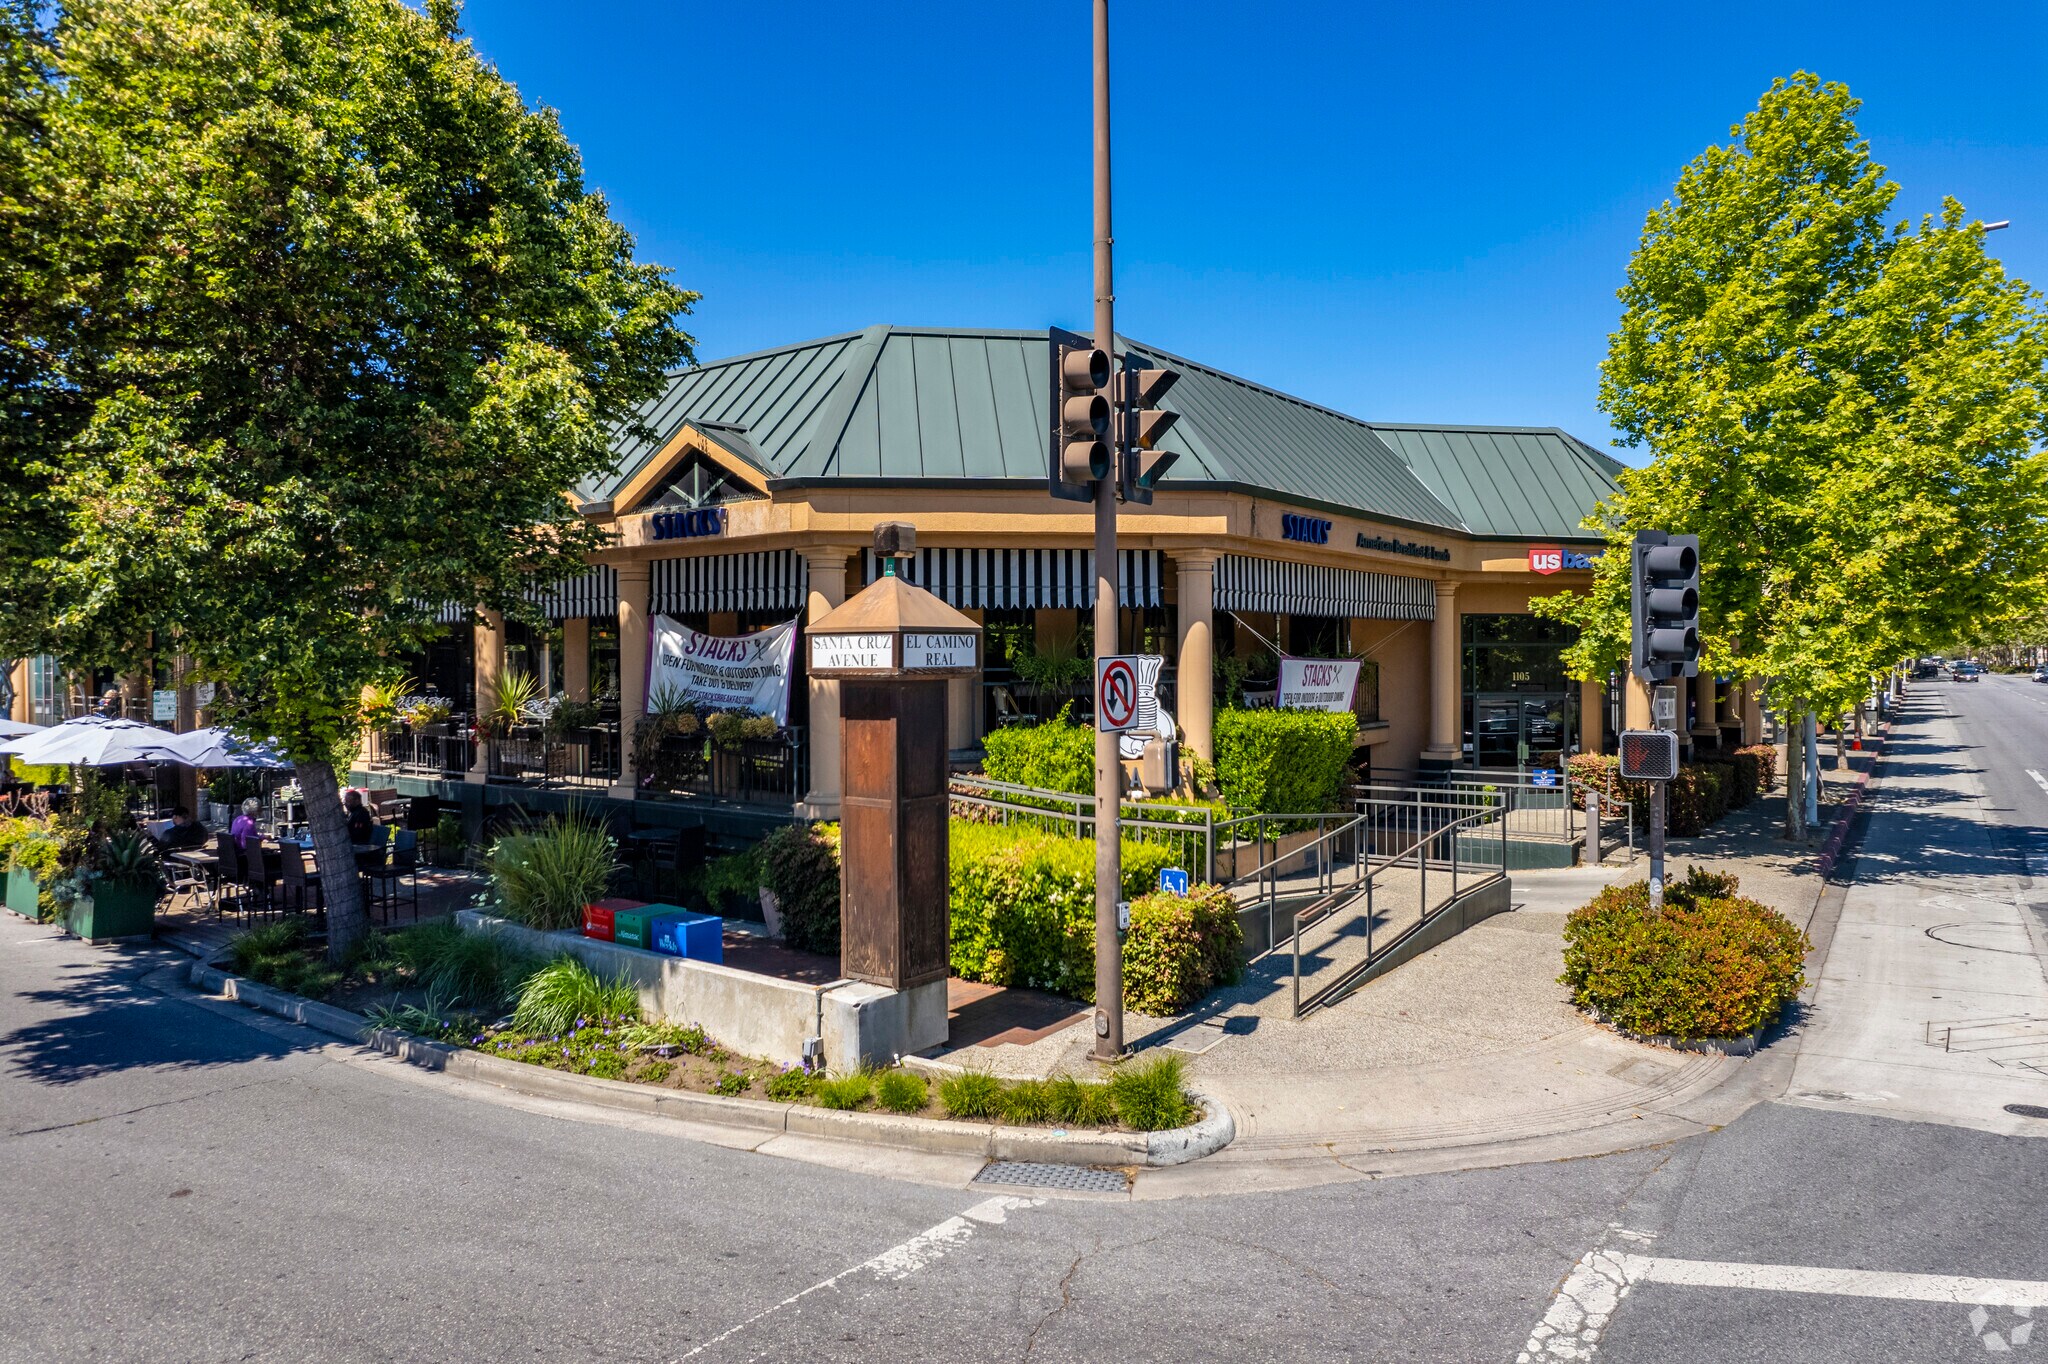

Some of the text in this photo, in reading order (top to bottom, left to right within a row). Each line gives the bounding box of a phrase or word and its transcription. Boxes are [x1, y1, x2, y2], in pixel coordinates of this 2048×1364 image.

[814, 635, 891, 650] SANTA CRUZ
[906, 635, 974, 649] EL CAMINO
[829, 654, 878, 667] AVENUE
[926, 653, 956, 666] REAL
[695, 662, 718, 676] DOOR
[725, 666, 760, 679] OUTDOOR
[1302, 664, 1332, 687] STACKS
[1512, 671, 1530, 681] 1105
[691, 675, 707, 687] TAKE
[726, 680, 754, 691] DELIVERY
